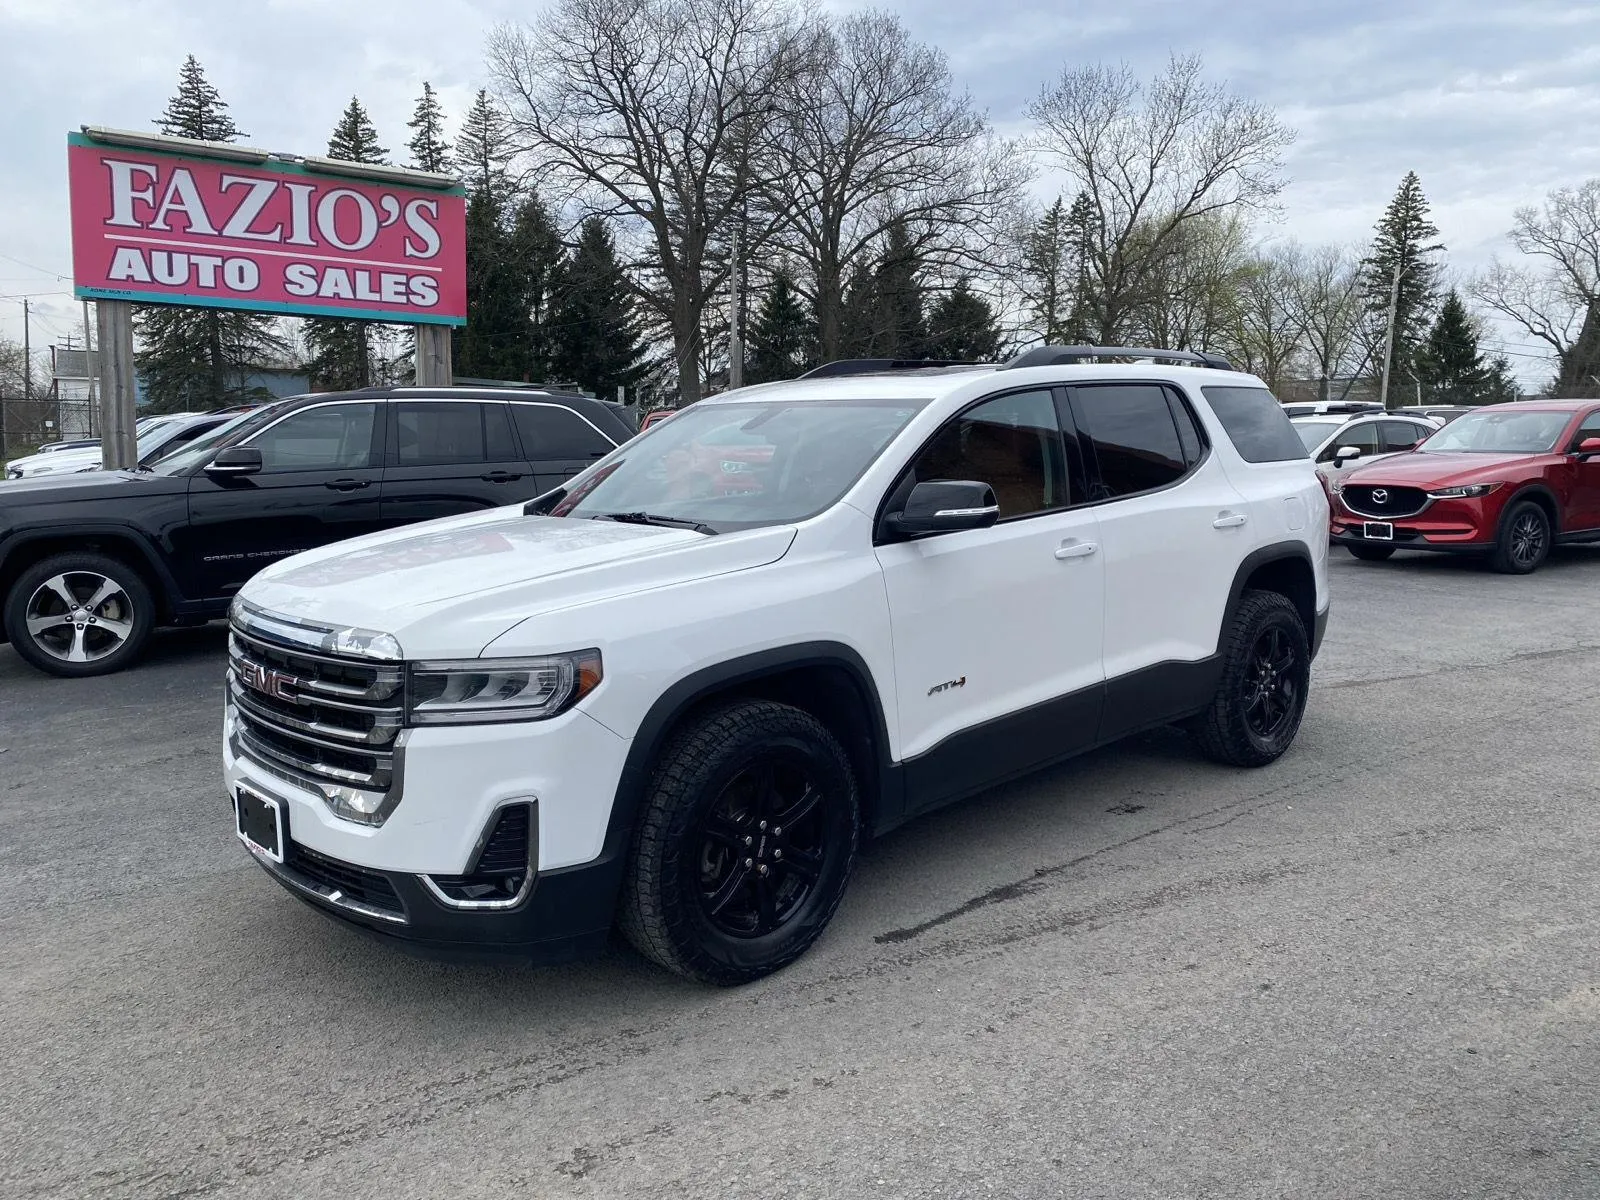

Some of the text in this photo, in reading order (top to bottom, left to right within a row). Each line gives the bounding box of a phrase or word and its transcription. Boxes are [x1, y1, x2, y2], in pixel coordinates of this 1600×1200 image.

[101, 157, 442, 260] FAZIO'S
[107, 246, 440, 308] AUTO SALES
[203, 553, 245, 562] GRAND
[240, 659, 299, 705] GMC
